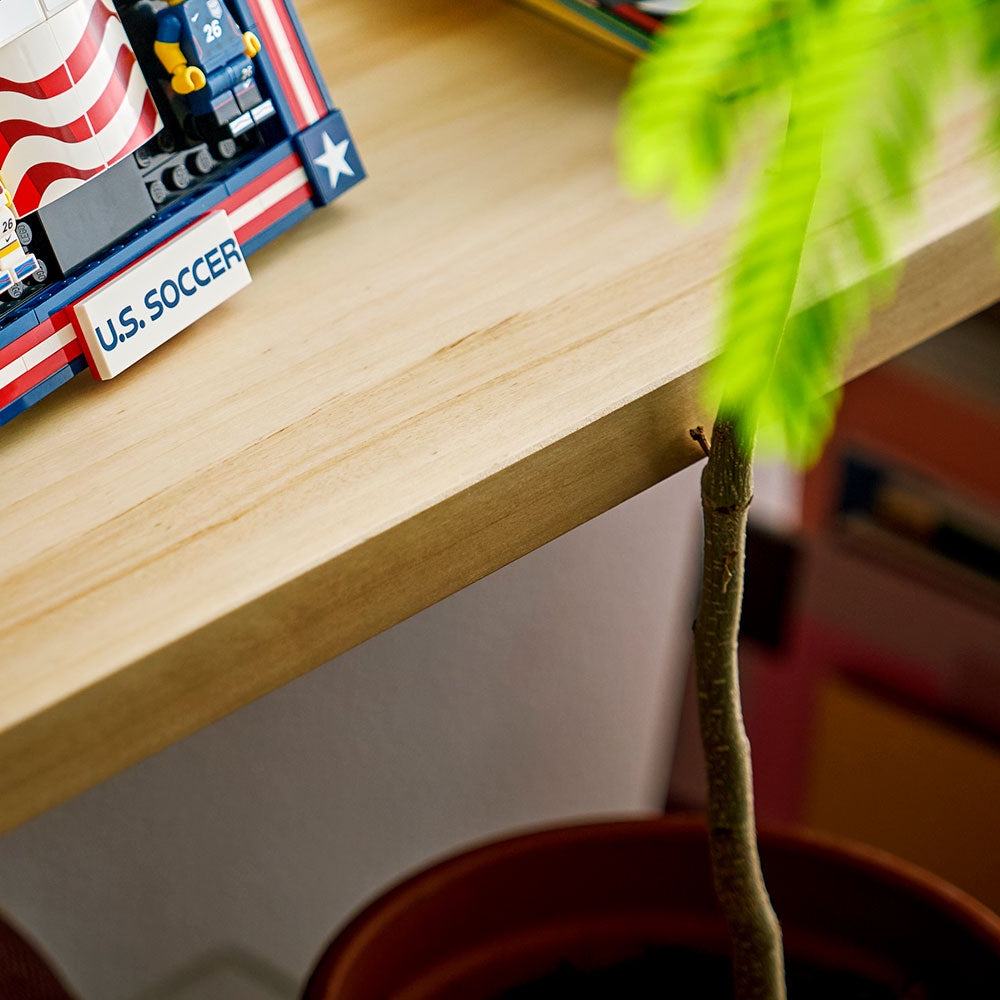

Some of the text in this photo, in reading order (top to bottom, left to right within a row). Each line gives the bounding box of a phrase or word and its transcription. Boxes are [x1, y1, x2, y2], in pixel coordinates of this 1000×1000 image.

[203, 19, 223, 43] 26
[2, 218, 14, 233] 26
[18, 224, 31, 243] LEGO
[95, 238, 242, 351] U.S. SOCCER
